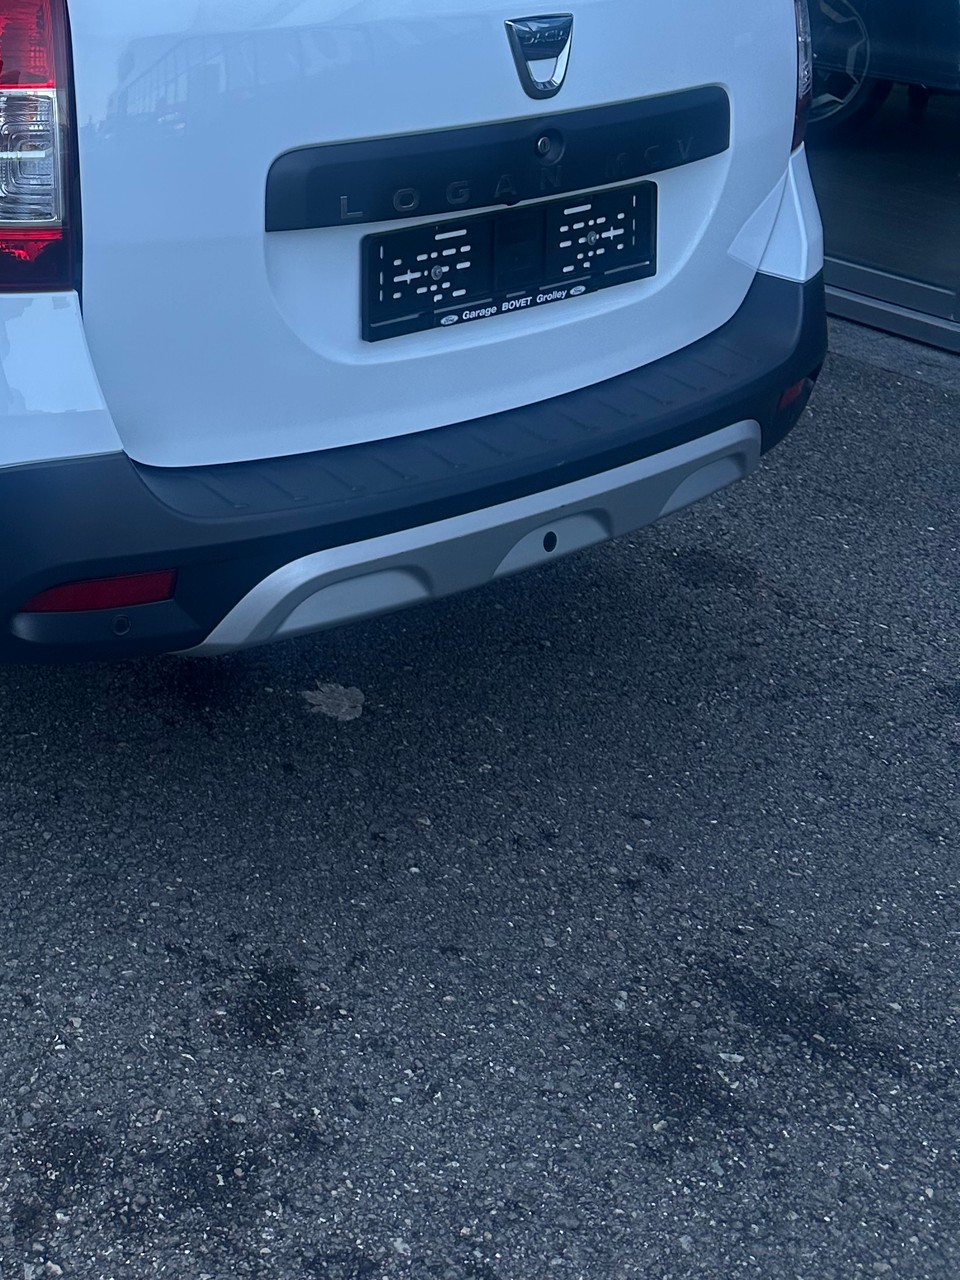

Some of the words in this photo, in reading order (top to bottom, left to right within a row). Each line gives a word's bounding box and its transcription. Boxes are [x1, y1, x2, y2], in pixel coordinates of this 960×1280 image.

[523, 30, 568, 45] DACIA
[340, 164, 563, 220] LOGAN
[604, 136, 696, 177] MCV
[462, 306, 497, 320] Garage
[501, 296, 533, 311] BOVET
[536, 289, 567, 303] Grolley
